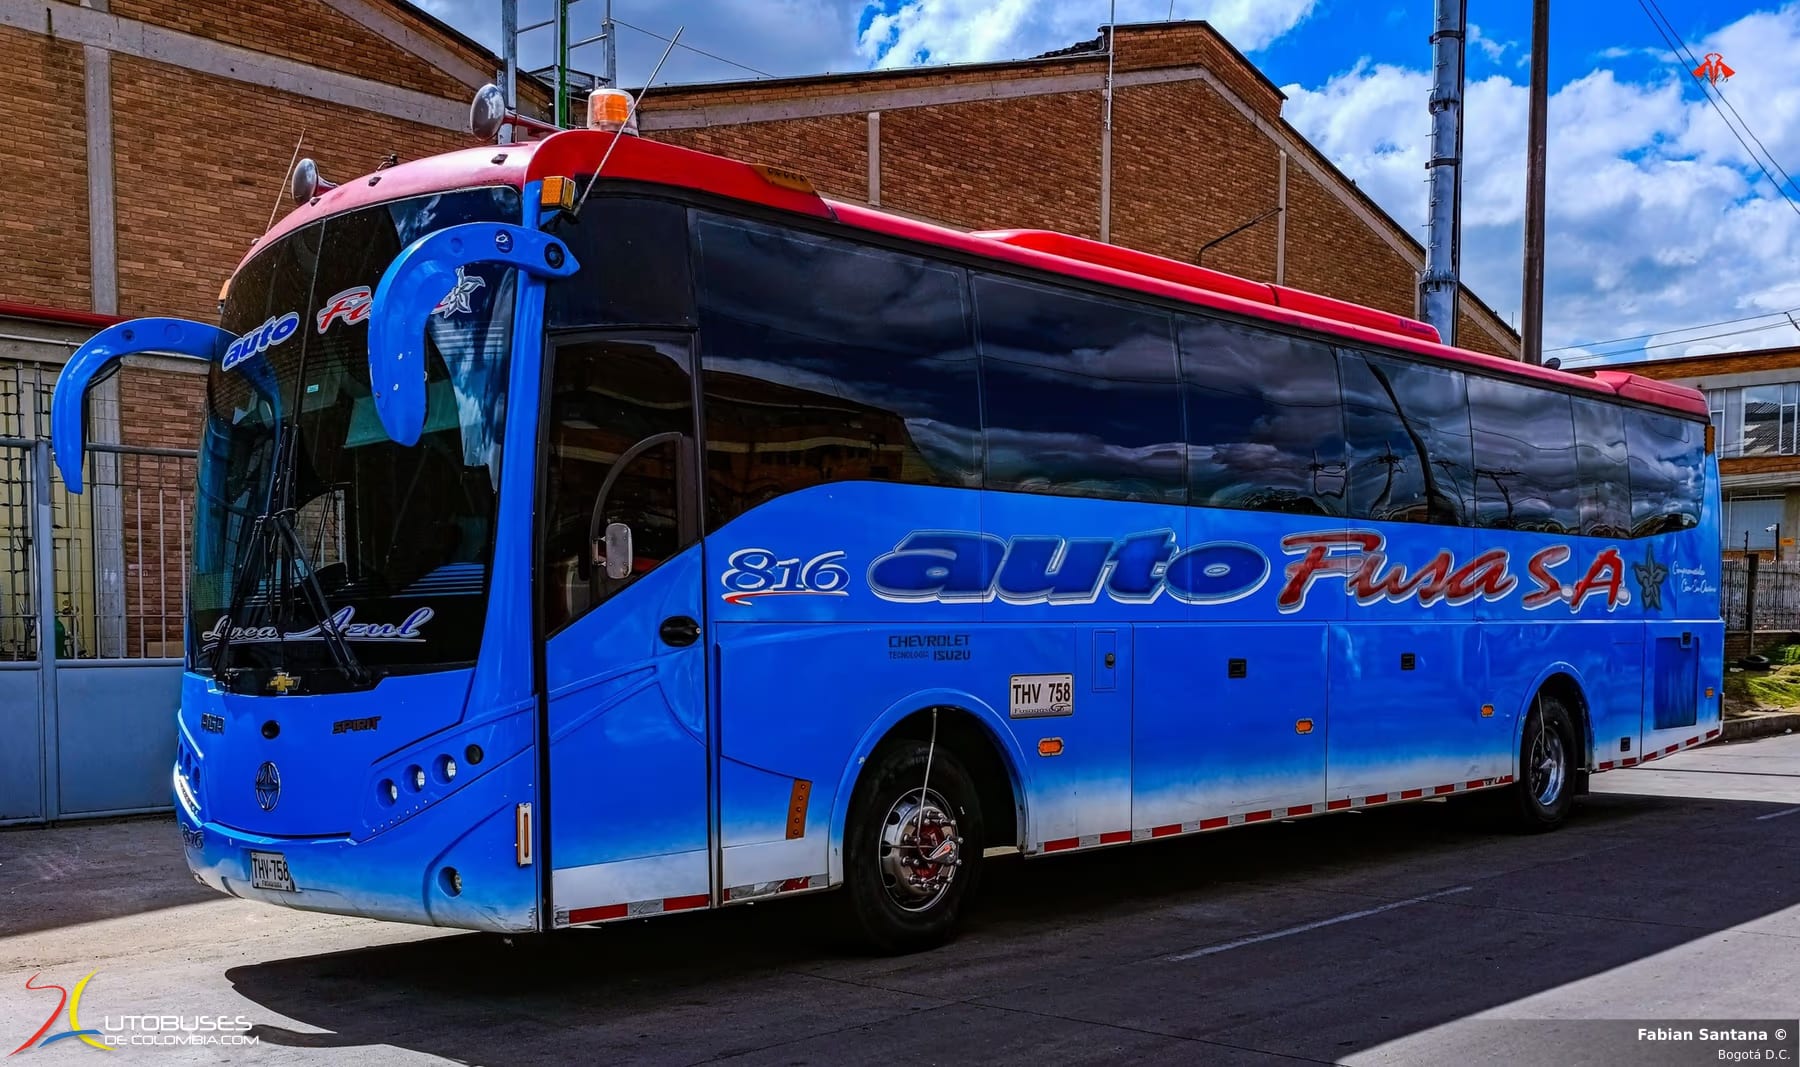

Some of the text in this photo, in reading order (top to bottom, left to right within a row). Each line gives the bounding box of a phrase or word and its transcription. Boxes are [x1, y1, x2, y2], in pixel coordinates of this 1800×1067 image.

[222, 311, 300, 372] auto
[721, 548, 850, 593] 816
[867, 528, 1271, 606] auto
[1278, 528, 1518, 615] Fusa
[283, 605, 435, 639] Azul
[888, 634, 971, 648] CHEVROLET
[933, 649, 971, 661] ISUZU
[1013, 682, 1071, 704] THV 758
[332, 715, 382, 735] SPIRIT
